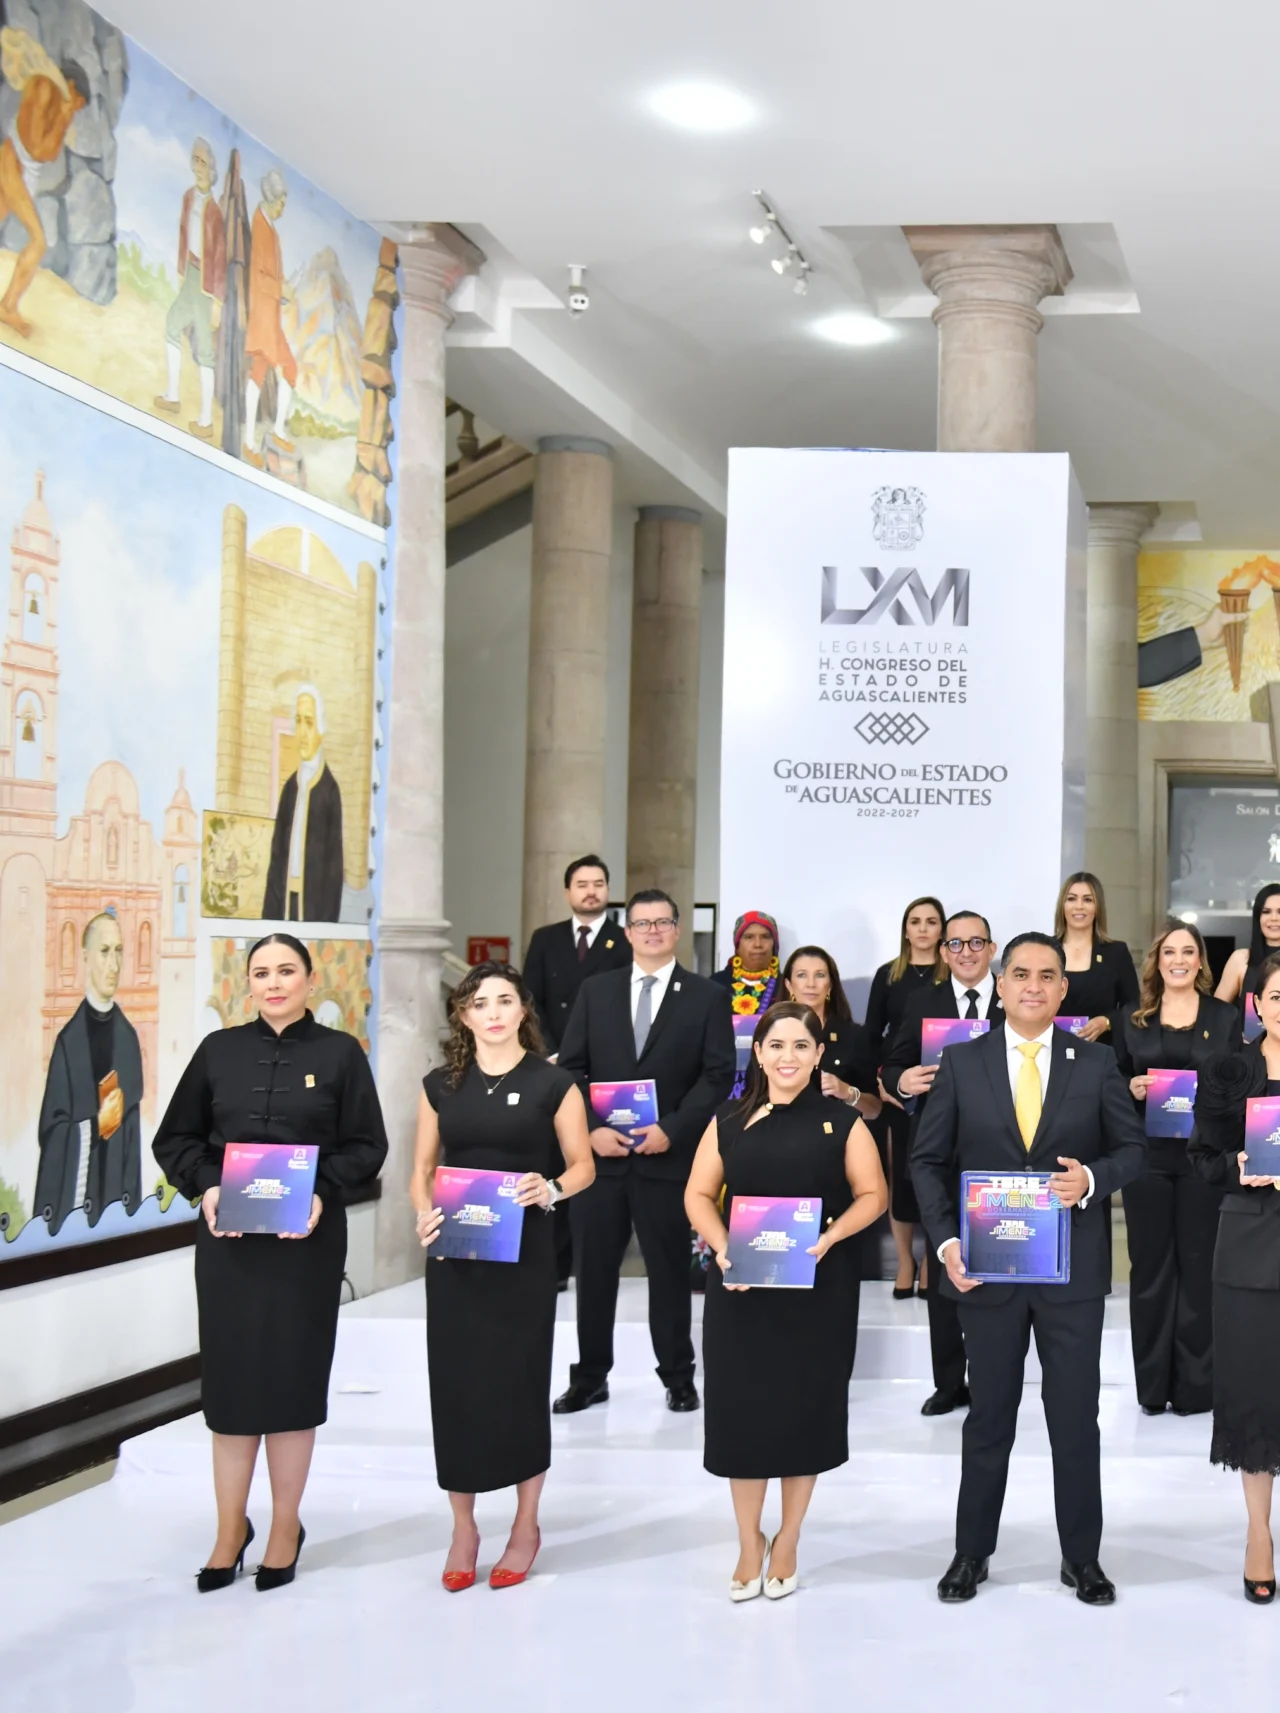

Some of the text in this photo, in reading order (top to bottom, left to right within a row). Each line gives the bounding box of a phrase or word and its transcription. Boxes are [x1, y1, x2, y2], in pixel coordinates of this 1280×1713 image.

[819, 640, 968, 655] LEGISLATURA
[819, 658, 967, 673] H. CONGRESO DEL
[819, 673, 967, 688] ESTADO DE
[819, 689, 968, 704] AGUASCALIENTES
[773, 759, 1008, 782] GOBIERNO DEL ESTADO
[785, 785, 992, 806] DE AGUASCALIENTES
[857, 807, 919, 818] 2022-2027
[989, 1177, 1040, 1188] TERE
